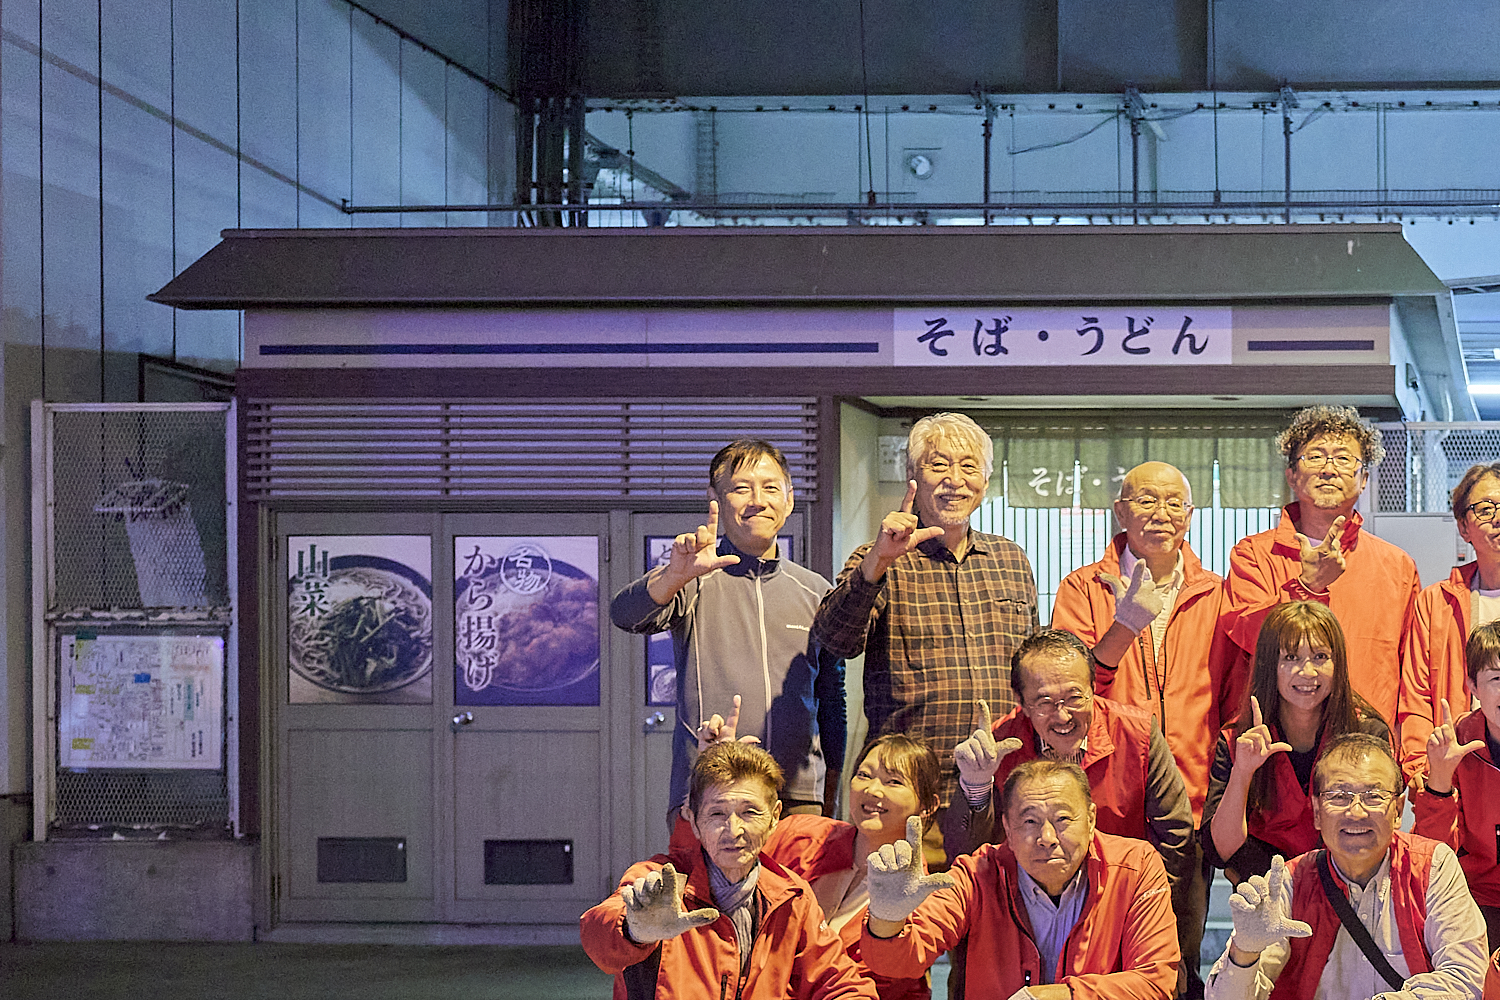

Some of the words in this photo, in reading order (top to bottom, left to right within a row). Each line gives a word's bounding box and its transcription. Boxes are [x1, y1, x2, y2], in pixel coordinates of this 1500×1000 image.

[917, 316, 1209, 356] そば・うどん
[296, 543, 330, 617] 山菜
[463, 545, 497, 690] から揚げ
